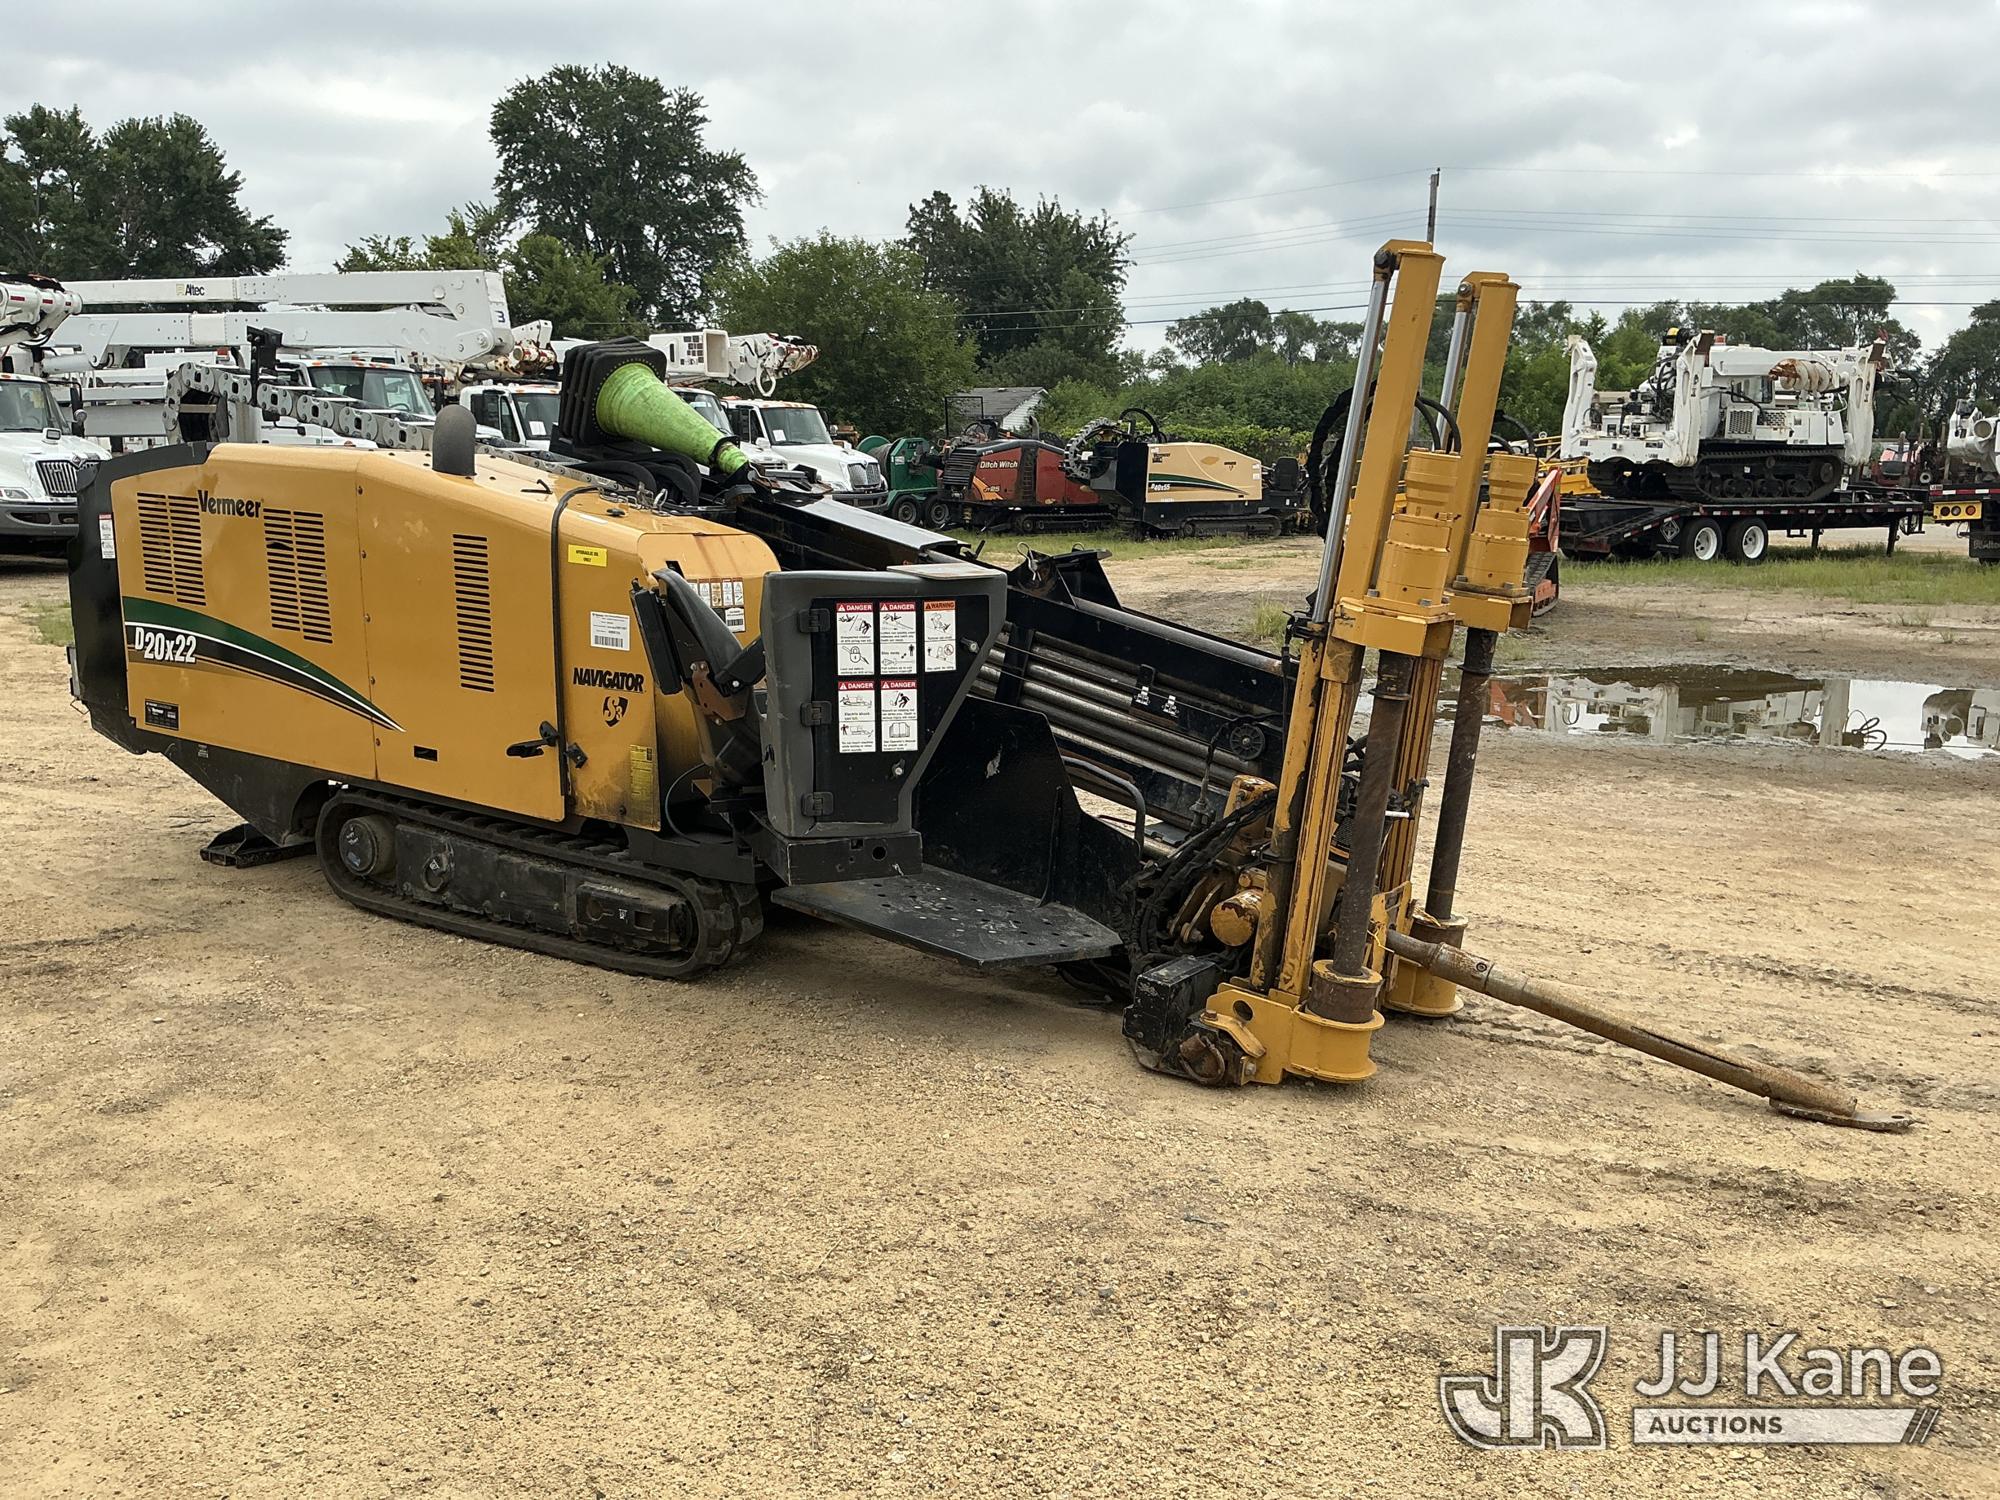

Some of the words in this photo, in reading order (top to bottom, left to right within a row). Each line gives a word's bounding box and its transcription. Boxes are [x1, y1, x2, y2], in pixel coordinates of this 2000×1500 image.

[185, 283, 205, 296] Altec
[980, 460, 998, 469] Ditch
[999, 460, 1018, 469] Witch
[198, 490, 262, 518] Vermeer
[134, 626, 197, 664] D20x22
[572, 666, 645, 693] NAVIGATOR
